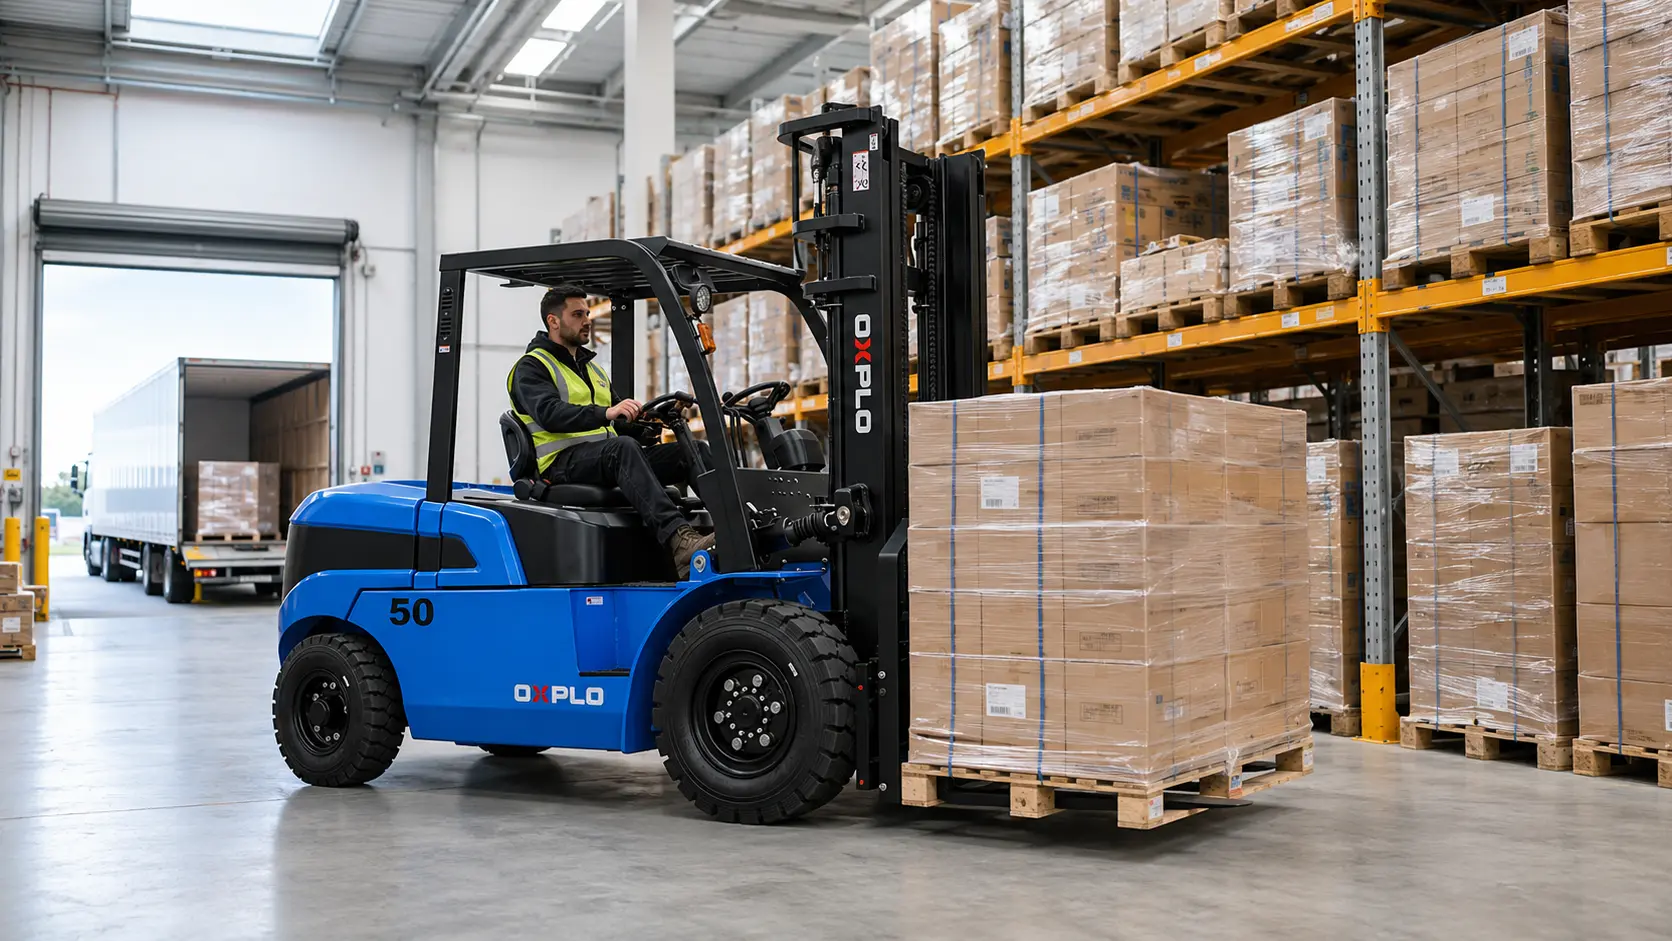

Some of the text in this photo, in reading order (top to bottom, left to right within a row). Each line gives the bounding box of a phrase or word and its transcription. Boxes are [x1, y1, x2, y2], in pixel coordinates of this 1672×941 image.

[855, 314, 872, 433] OXPLO
[389, 598, 434, 626] 50
[514, 684, 604, 706] OXPLO
